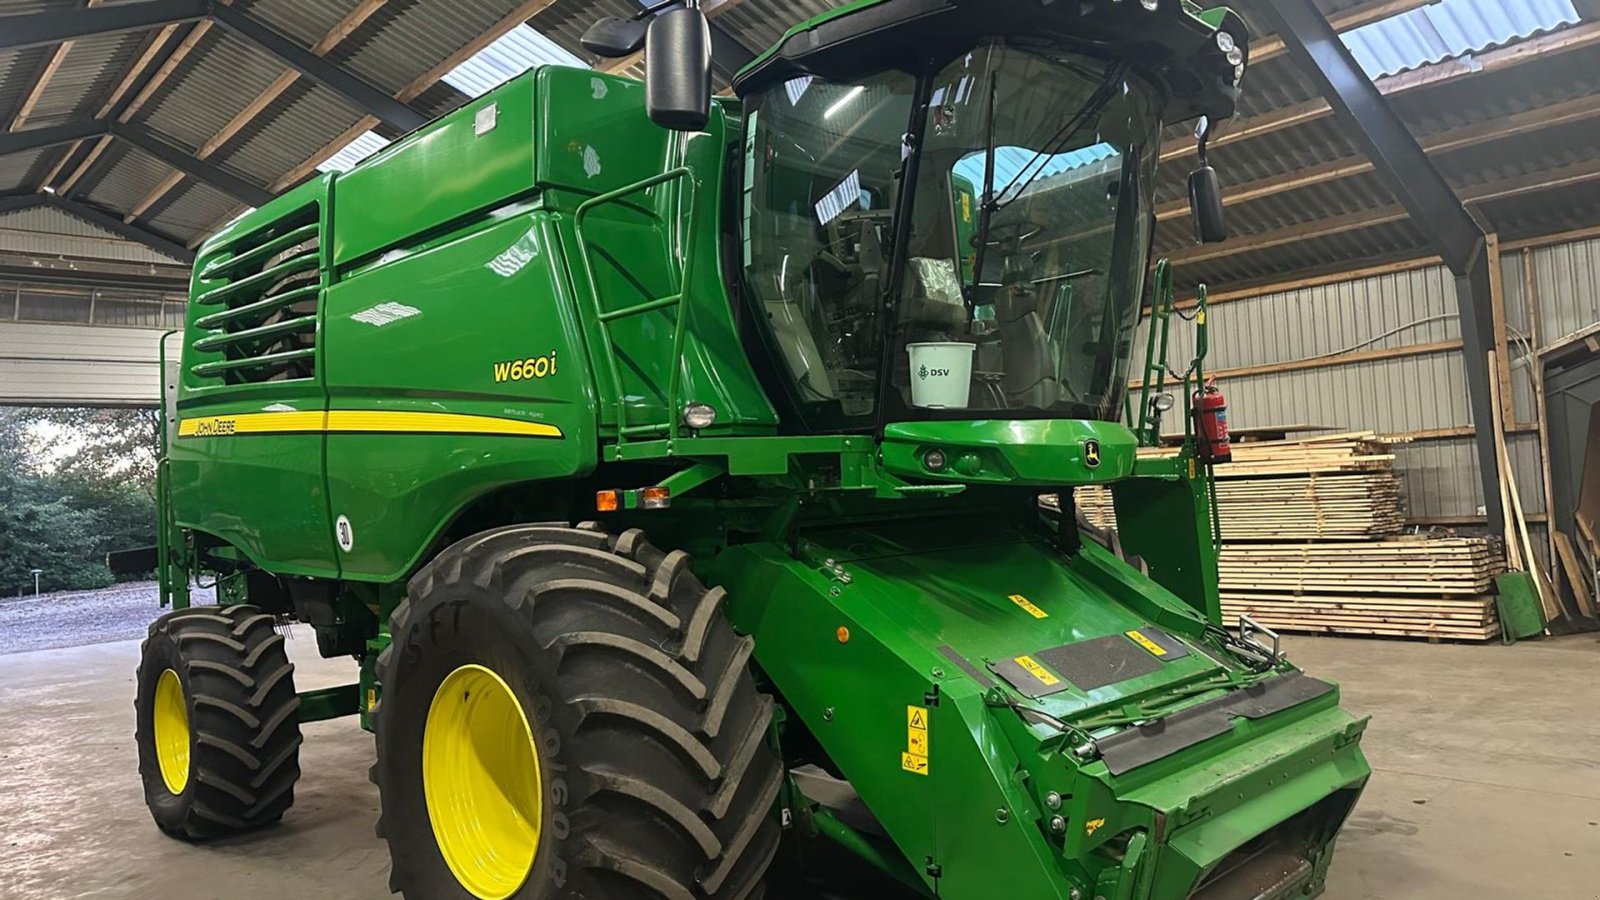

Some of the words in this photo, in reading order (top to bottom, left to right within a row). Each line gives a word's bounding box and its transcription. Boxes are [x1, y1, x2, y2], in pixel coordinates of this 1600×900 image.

[494, 350, 557, 382] W660i
[931, 368, 950, 376] DSV
[194, 420, 213, 436] JOHN
[212, 418, 236, 434] DEERE
[339, 521, 350, 545] 30
